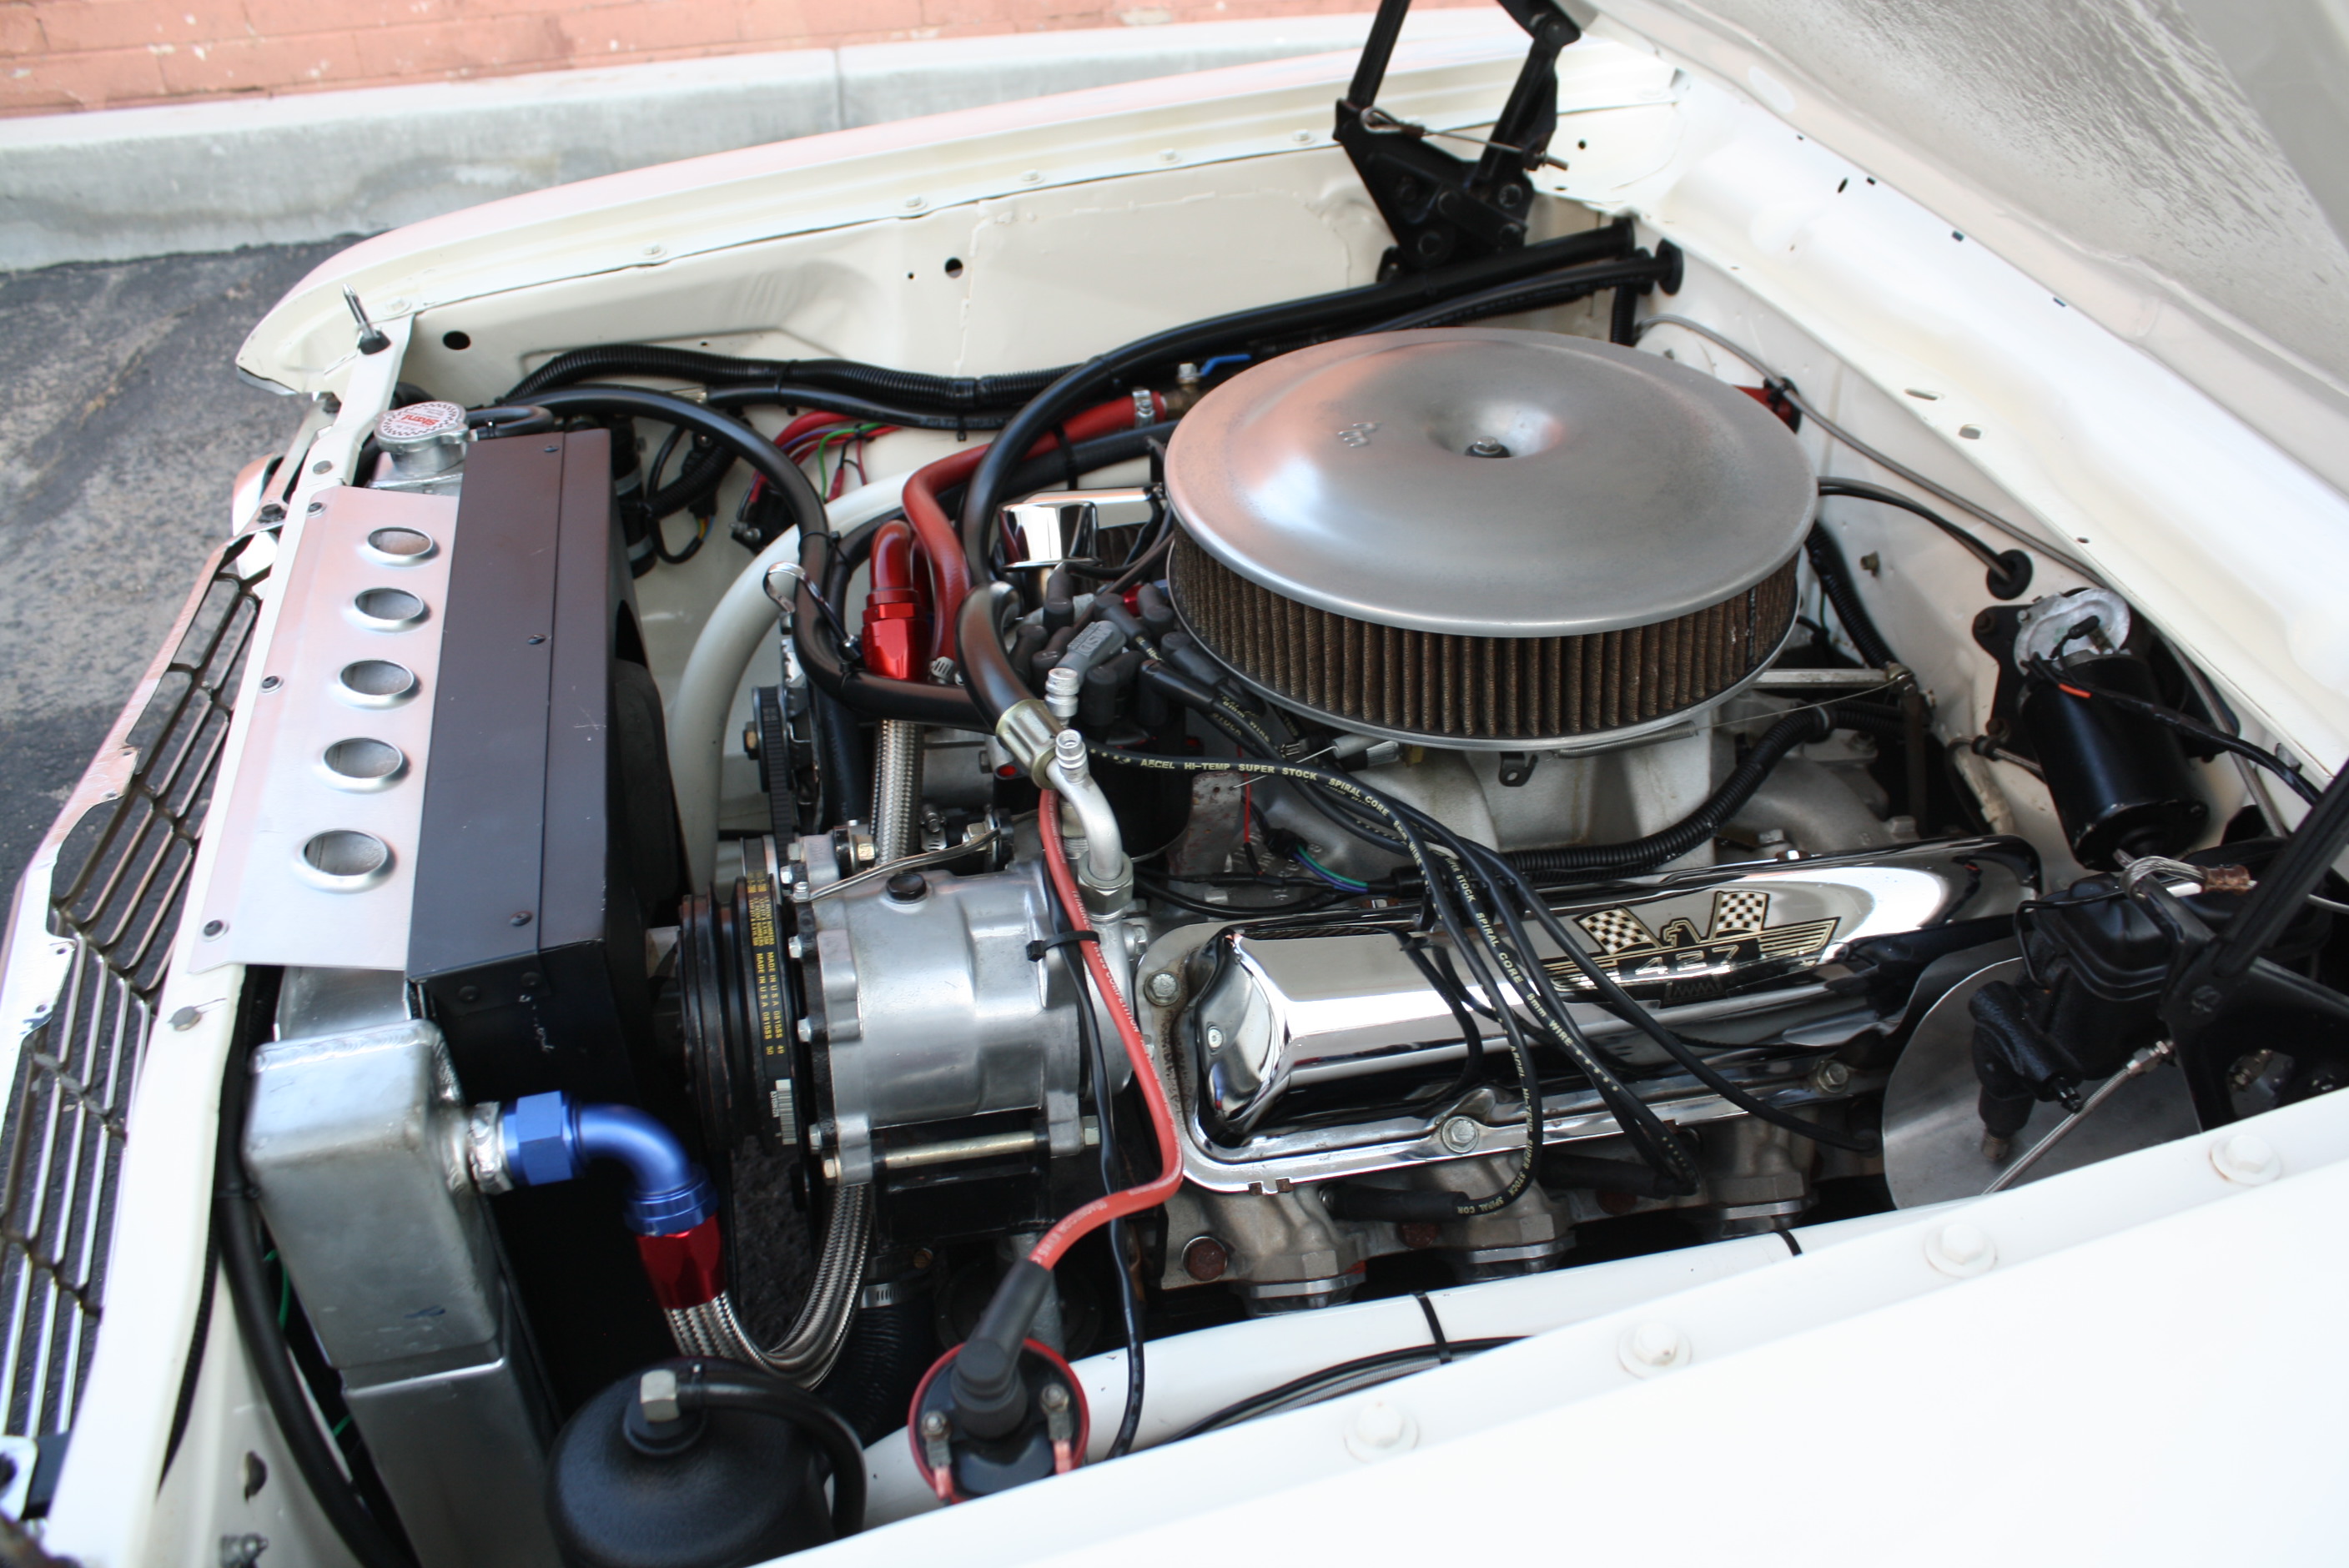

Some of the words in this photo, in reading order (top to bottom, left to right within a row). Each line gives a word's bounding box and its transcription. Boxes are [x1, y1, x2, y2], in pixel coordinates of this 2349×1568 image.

[401, 415, 440, 425] Stant
[1076, 626, 1113, 657] MSD
[1184, 762, 1230, 771] HI-TEMP
[1238, 763, 1275, 774] SUPER
[1281, 766, 1318, 781] STOCK
[1328, 777, 1361, 797] SPIRAL
[1364, 795, 1391, 817] CORE
[756, 953, 766, 974] MADE
[767, 952, 776, 972] MADE
[1456, 874, 1476, 902] STOCK
[1476, 912, 1500, 947] SPIRAL
[1499, 952, 1523, 984] CORE
[1527, 993, 1547, 1018] 8mm
[1548, 1019, 1574, 1047] WIRE
[1635, 944, 1739, 975] 427
[769, 974, 777, 983] IN
[1507, 1171, 1526, 1196] STOCK
[1456, 1206, 1476, 1214] COR
[1478, 1196, 1504, 1212] SPIRAL
